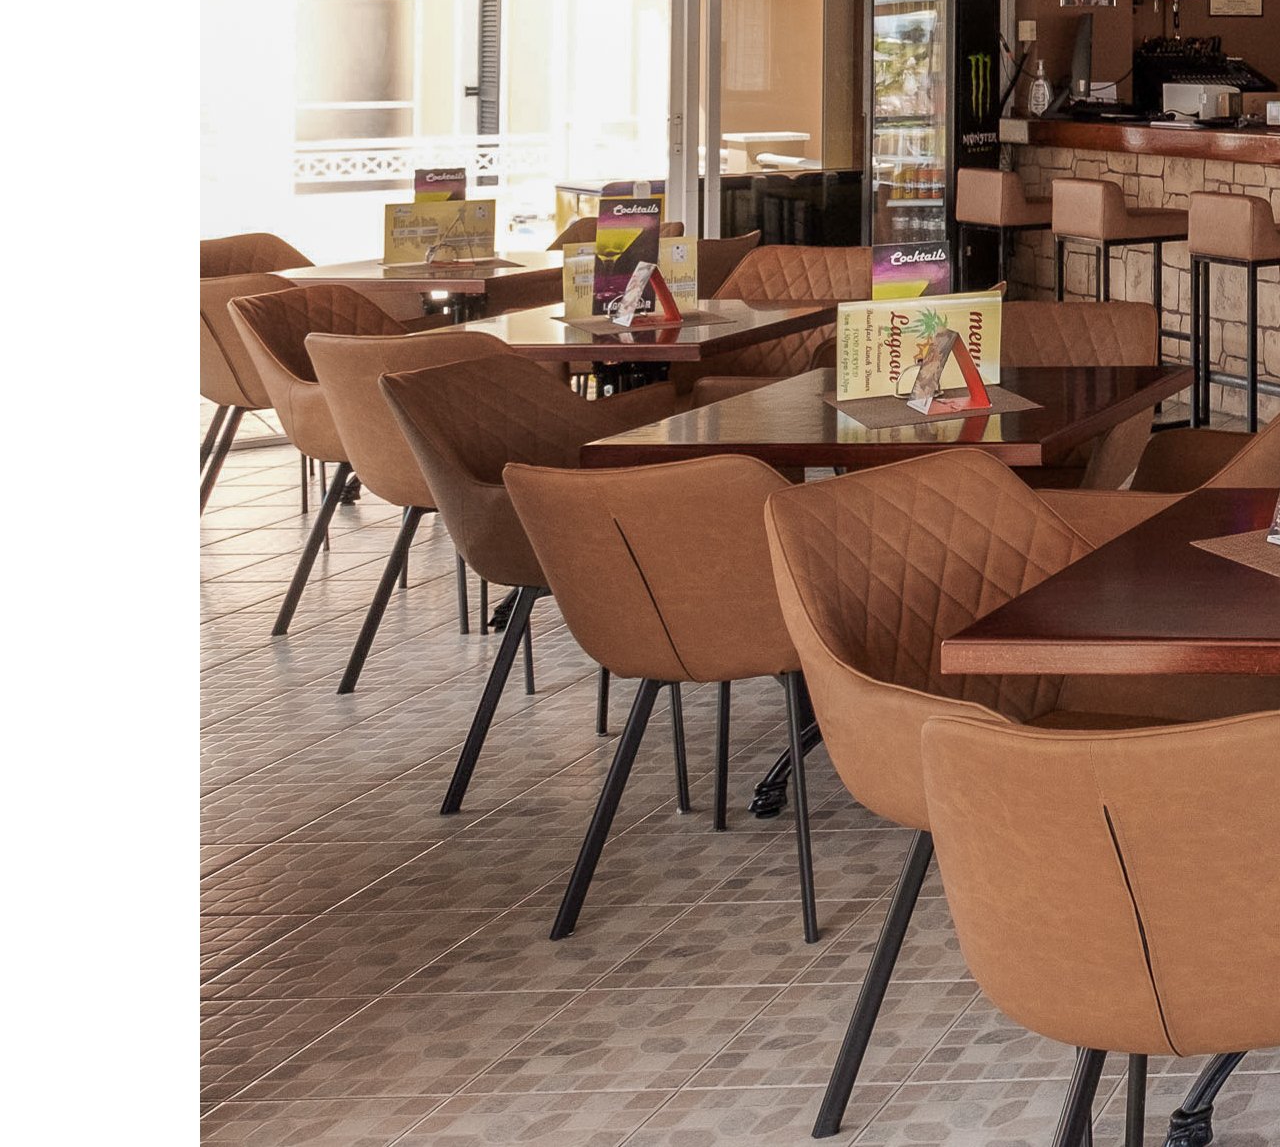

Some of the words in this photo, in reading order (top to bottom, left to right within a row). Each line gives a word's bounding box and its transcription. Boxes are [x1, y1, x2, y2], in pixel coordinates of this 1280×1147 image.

[962, 132, 998, 145] MONSTER
[426, 171, 465, 182] Cocktails
[613, 203, 660, 215] Cocktails
[890, 248, 947, 266] Cocktails
[864, 309, 874, 342] Breakfast
[864, 345, 873, 366] Lunch
[884, 311, 910, 383] Lagoon
[864, 369, 873, 392] Dinner
